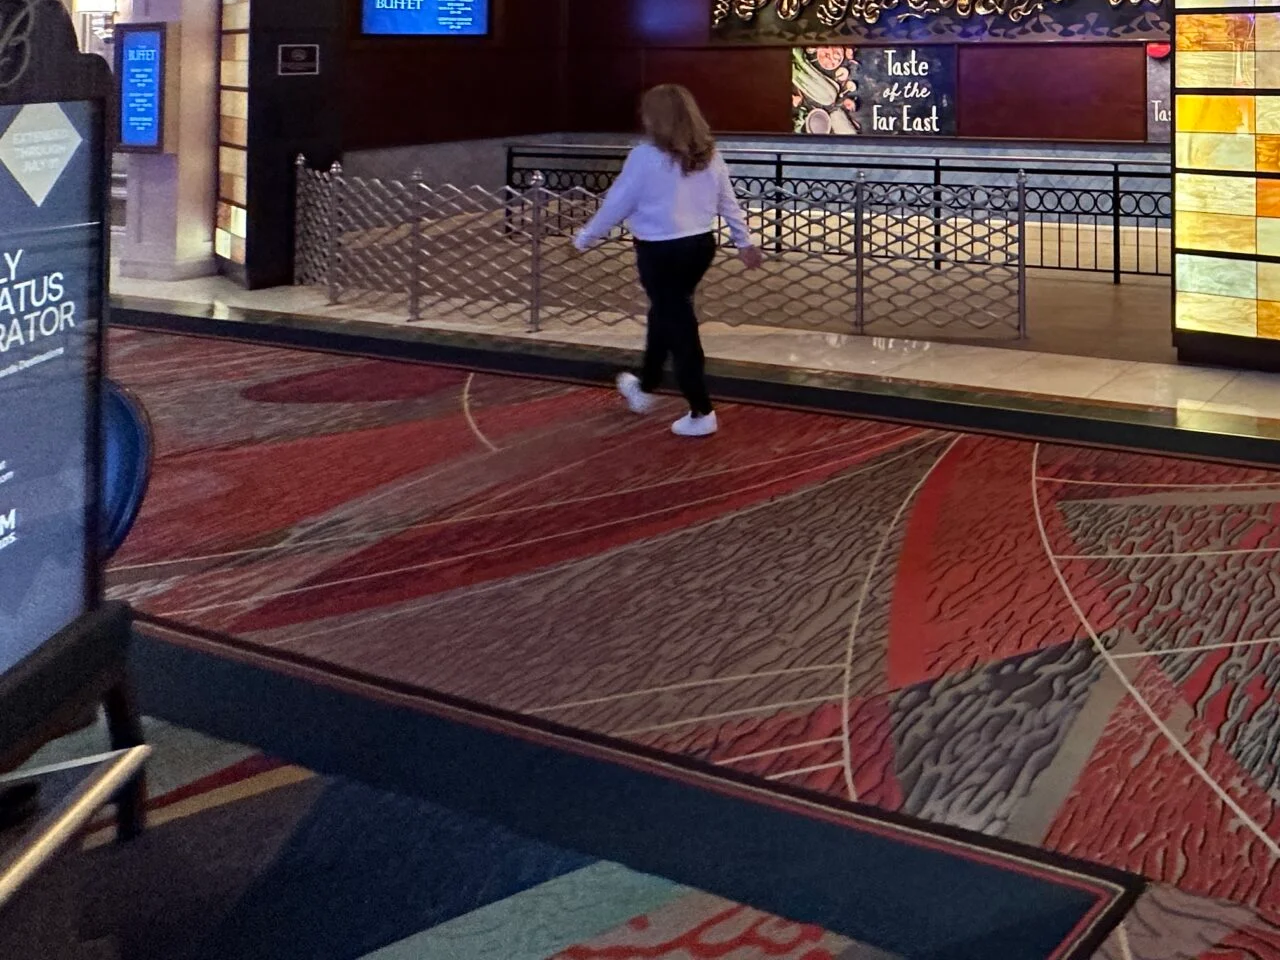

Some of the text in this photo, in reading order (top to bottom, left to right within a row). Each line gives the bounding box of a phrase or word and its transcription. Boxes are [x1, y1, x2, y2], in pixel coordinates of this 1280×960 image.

[883, 49, 929, 76] Taste
[882, 81, 931, 103] of the
[873, 105, 940, 132] Far East
